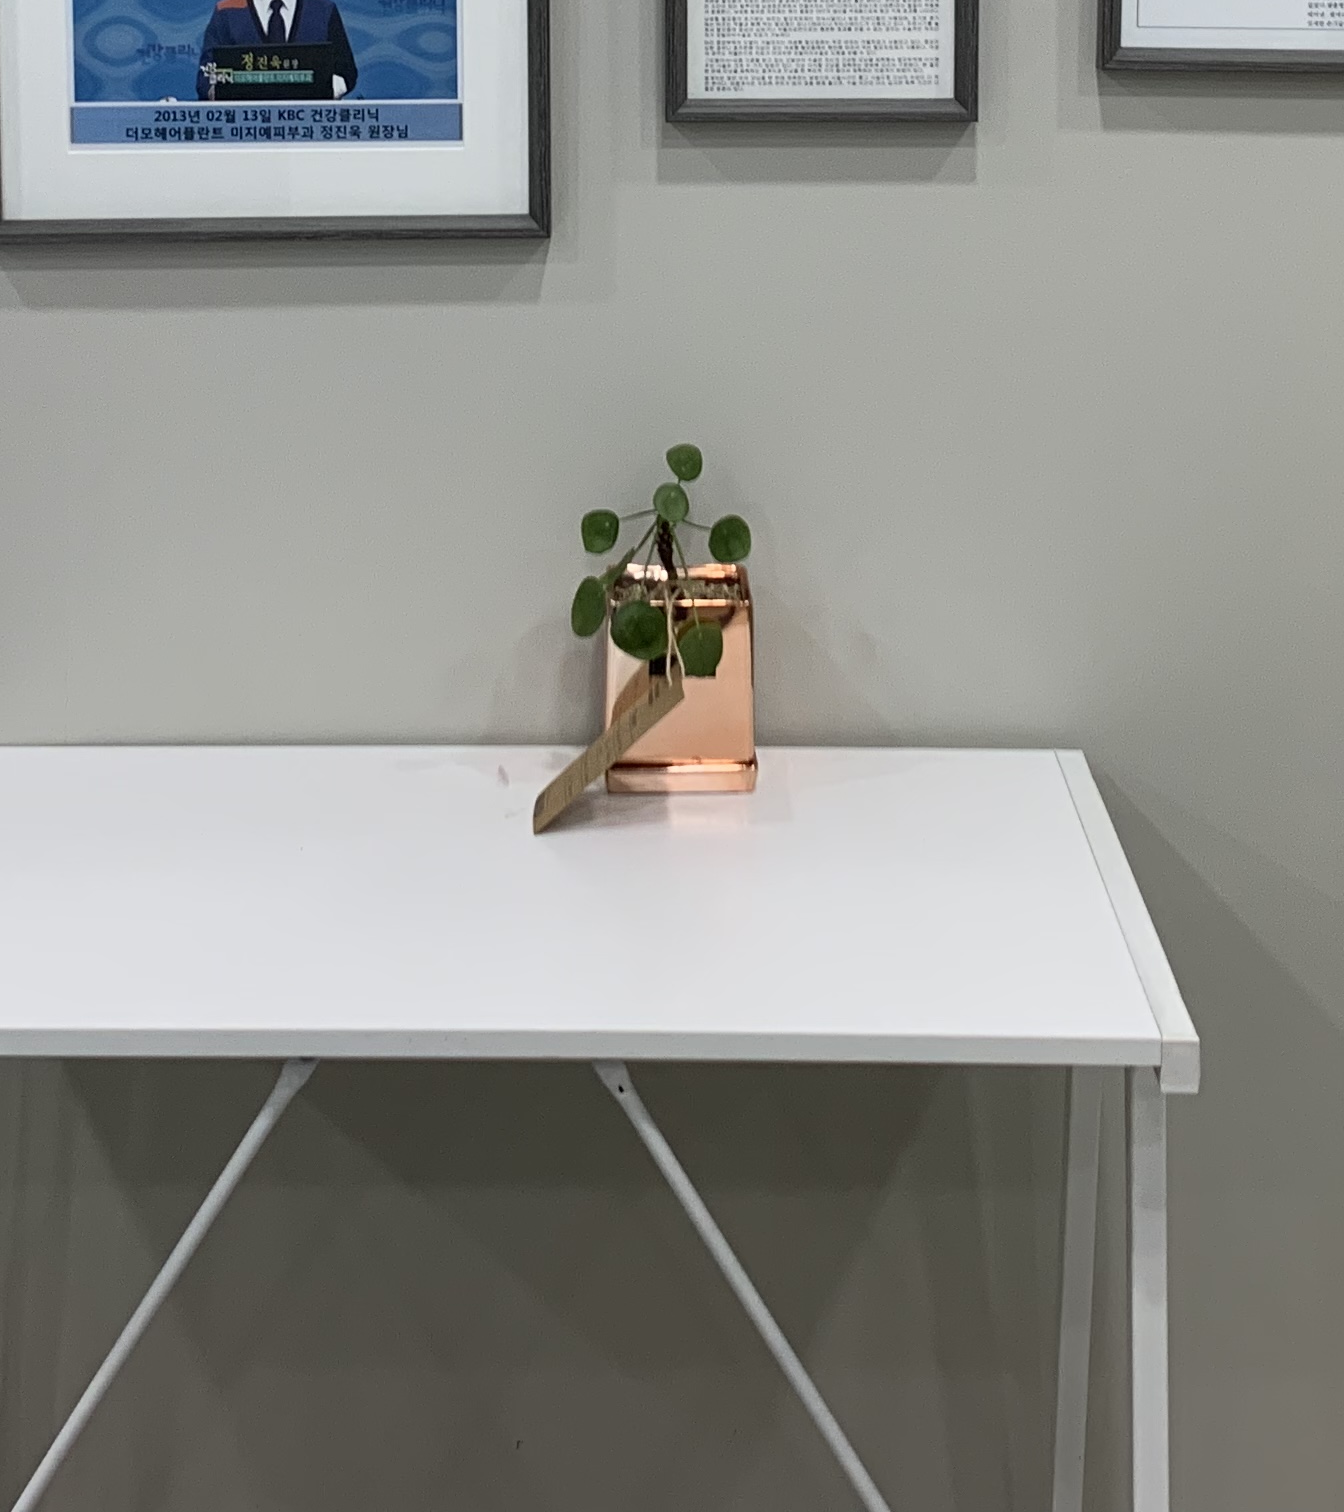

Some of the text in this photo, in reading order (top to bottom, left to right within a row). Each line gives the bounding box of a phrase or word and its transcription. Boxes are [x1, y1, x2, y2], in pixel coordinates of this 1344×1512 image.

[241, 51, 283, 71] 정진욱
[154, 108, 378, 123] 2013년 02월 13일 KBC 건강클리닉
[126, 123, 408, 141] 더모헤어플란트 미지예피부과 정진욱 원장님
